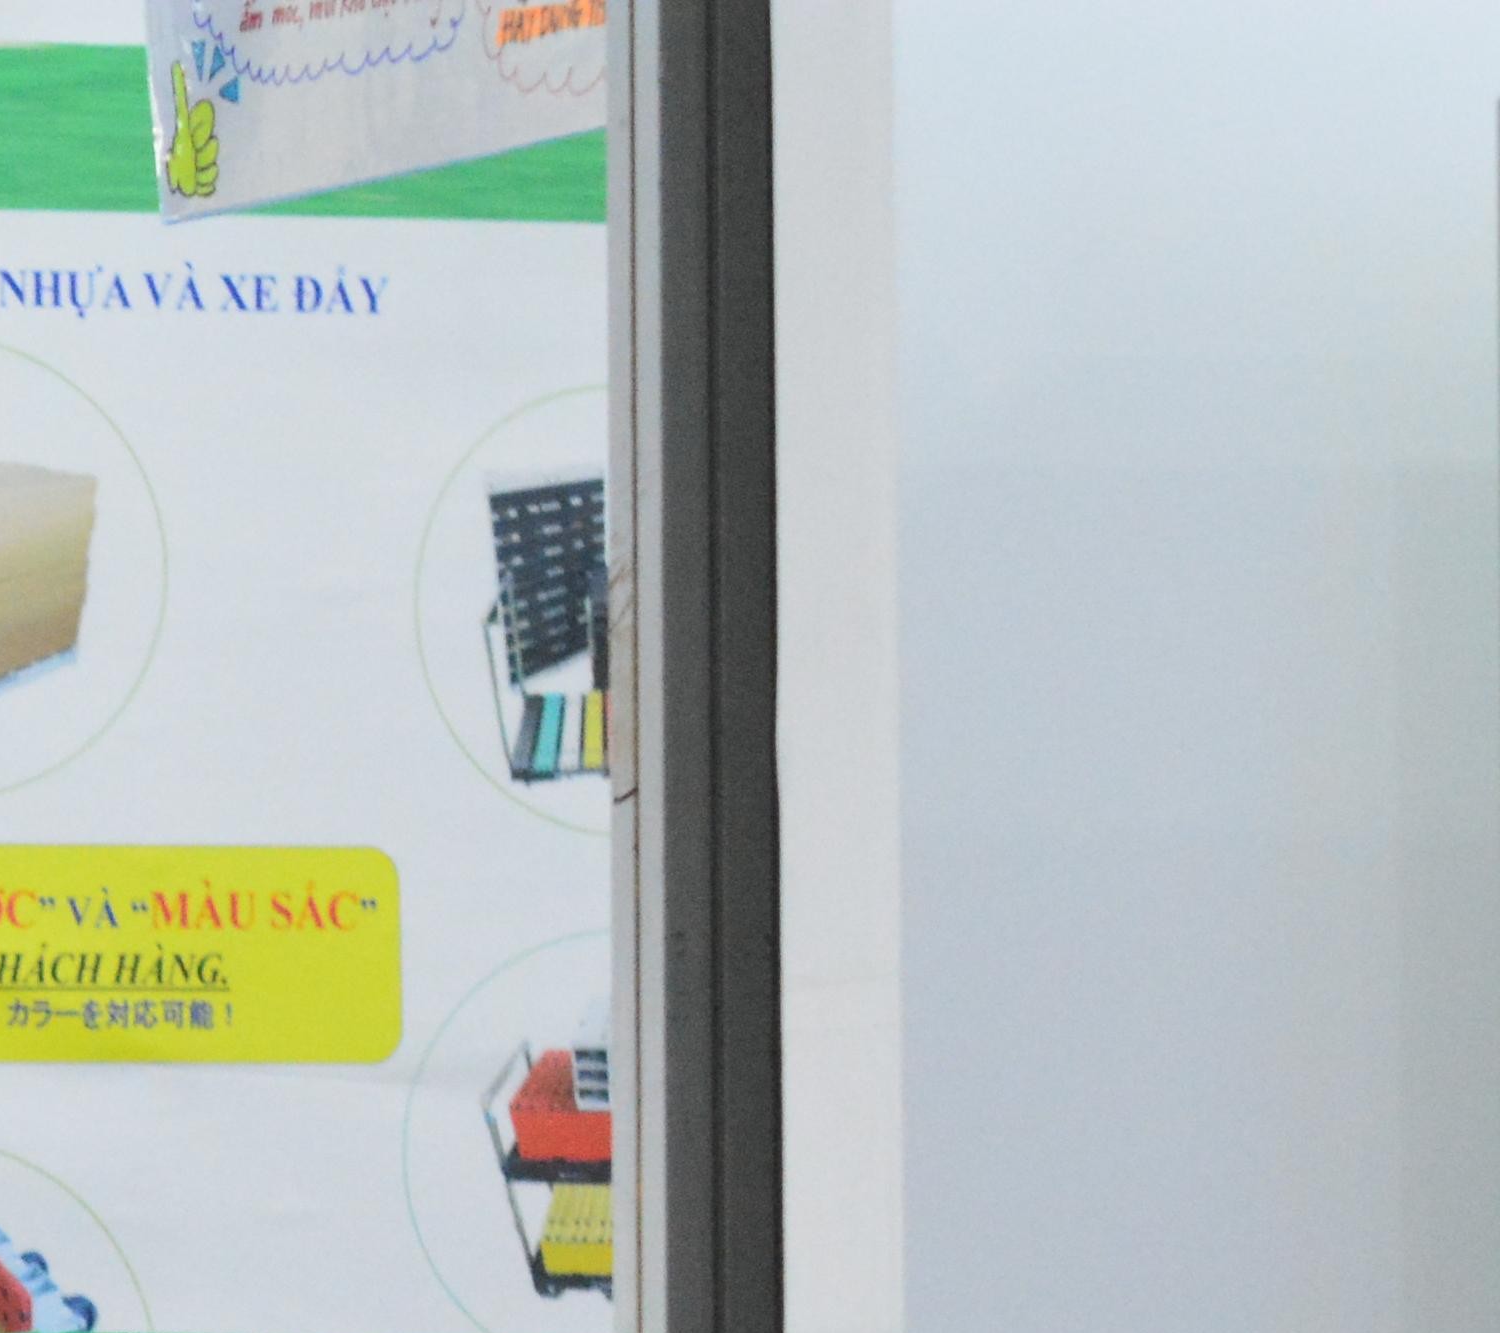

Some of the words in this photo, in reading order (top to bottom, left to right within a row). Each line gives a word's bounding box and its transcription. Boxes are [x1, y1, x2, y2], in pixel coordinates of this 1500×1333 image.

[0, 264, 133, 319] NHỰA
[143, 260, 205, 312] VÀ
[219, 273, 280, 314] XE
[66, 886, 118, 929] VÀ
[131, 879, 257, 931] “MÀU
[113, 942, 229, 986] HÀNG.
